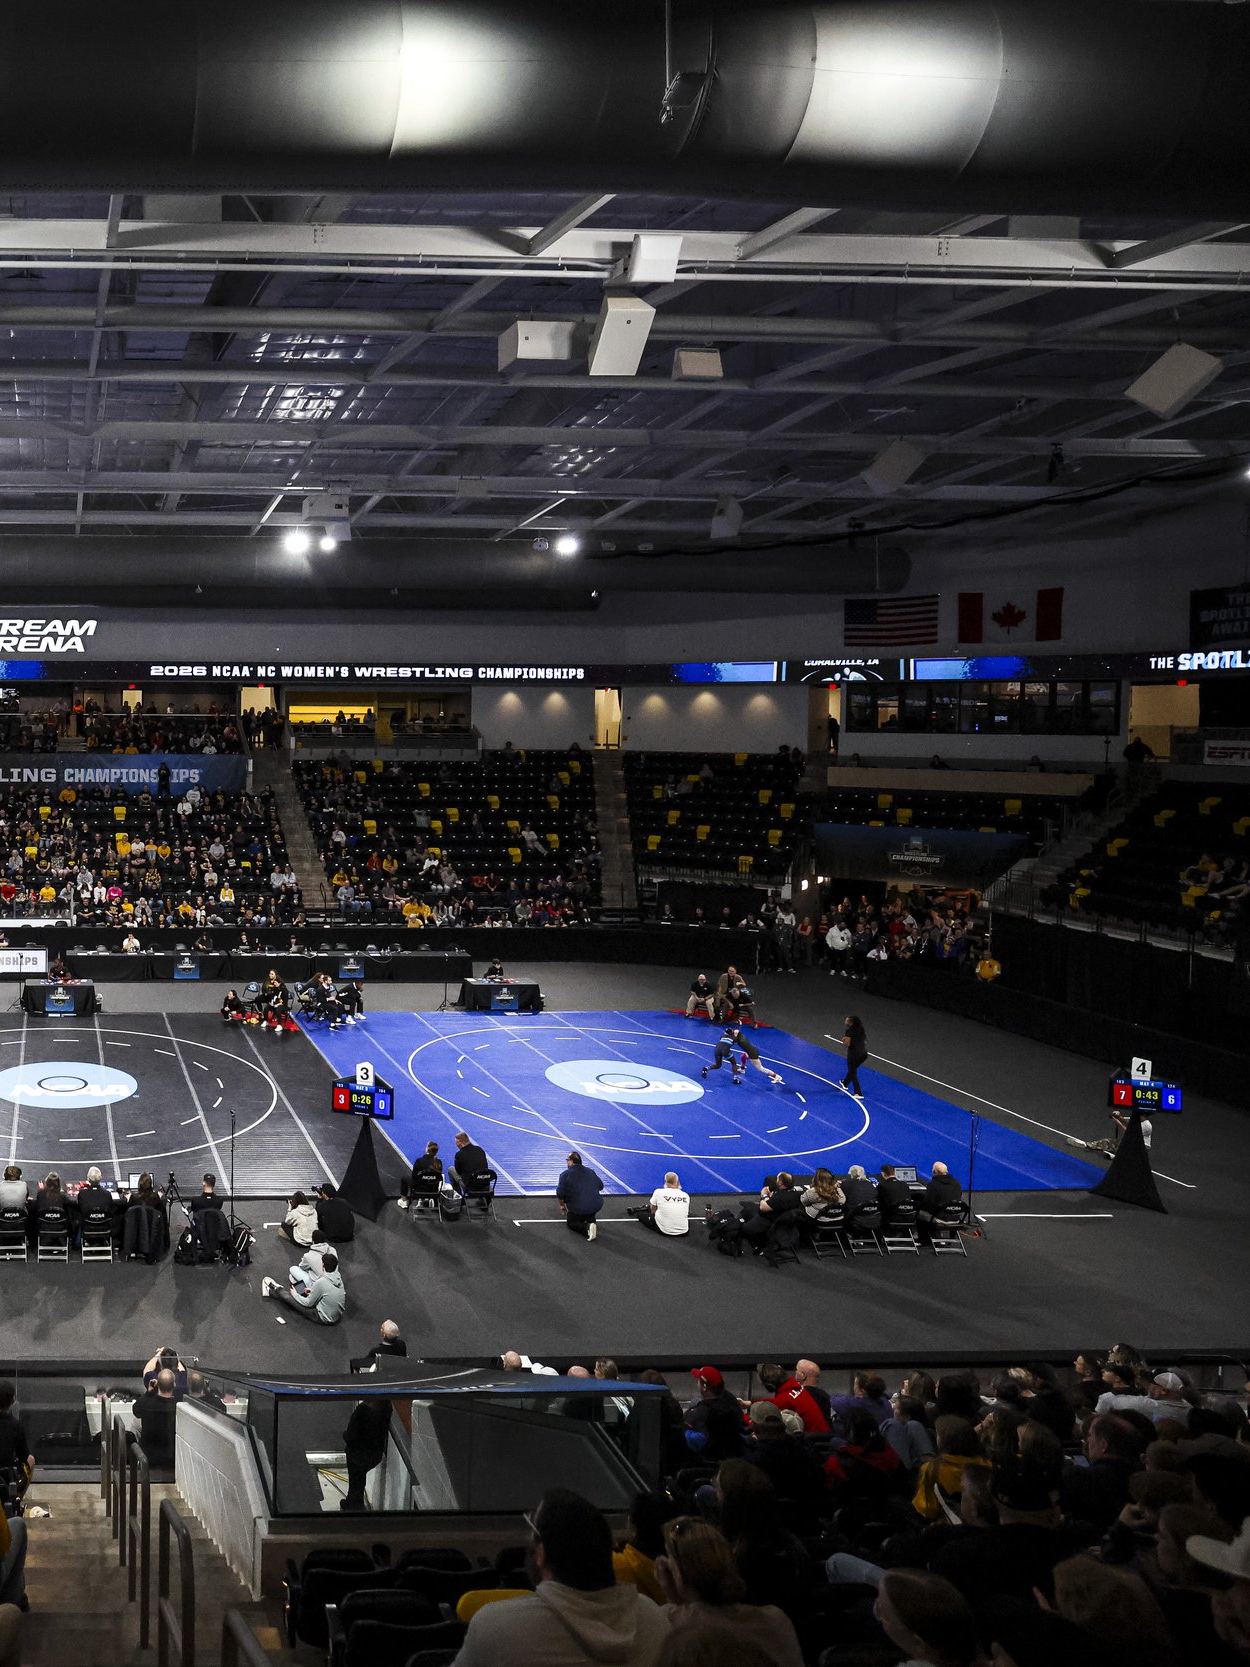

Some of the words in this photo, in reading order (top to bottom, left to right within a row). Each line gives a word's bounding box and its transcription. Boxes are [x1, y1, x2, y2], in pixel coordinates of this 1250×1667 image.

[1149, 656, 1174, 669] THE
[150, 665, 207, 676] 2026
[212, 665, 251, 677] NCAA
[257, 666, 275, 677] NC
[281, 666, 349, 677] WOMEN'S
[354, 666, 473, 678] WRESTLING
[478, 667, 584, 679] CHAMPIONSHIPS
[64, 768, 200, 783] CHAMPIONSIPS
[892, 854, 940, 863] CHAMPIONSHIPS
[360, 1067, 369, 1080] 3
[1136, 1062, 1147, 1075] 4
[338, 1094, 345, 1104] 3
[352, 1094, 371, 1104] 0:26
[1119, 1090, 1126, 1100] 7
[1135, 1090, 1159, 1100] 0:43
[1168, 1095, 1175, 1105] 6
[379, 1100, 385, 1110] 0
